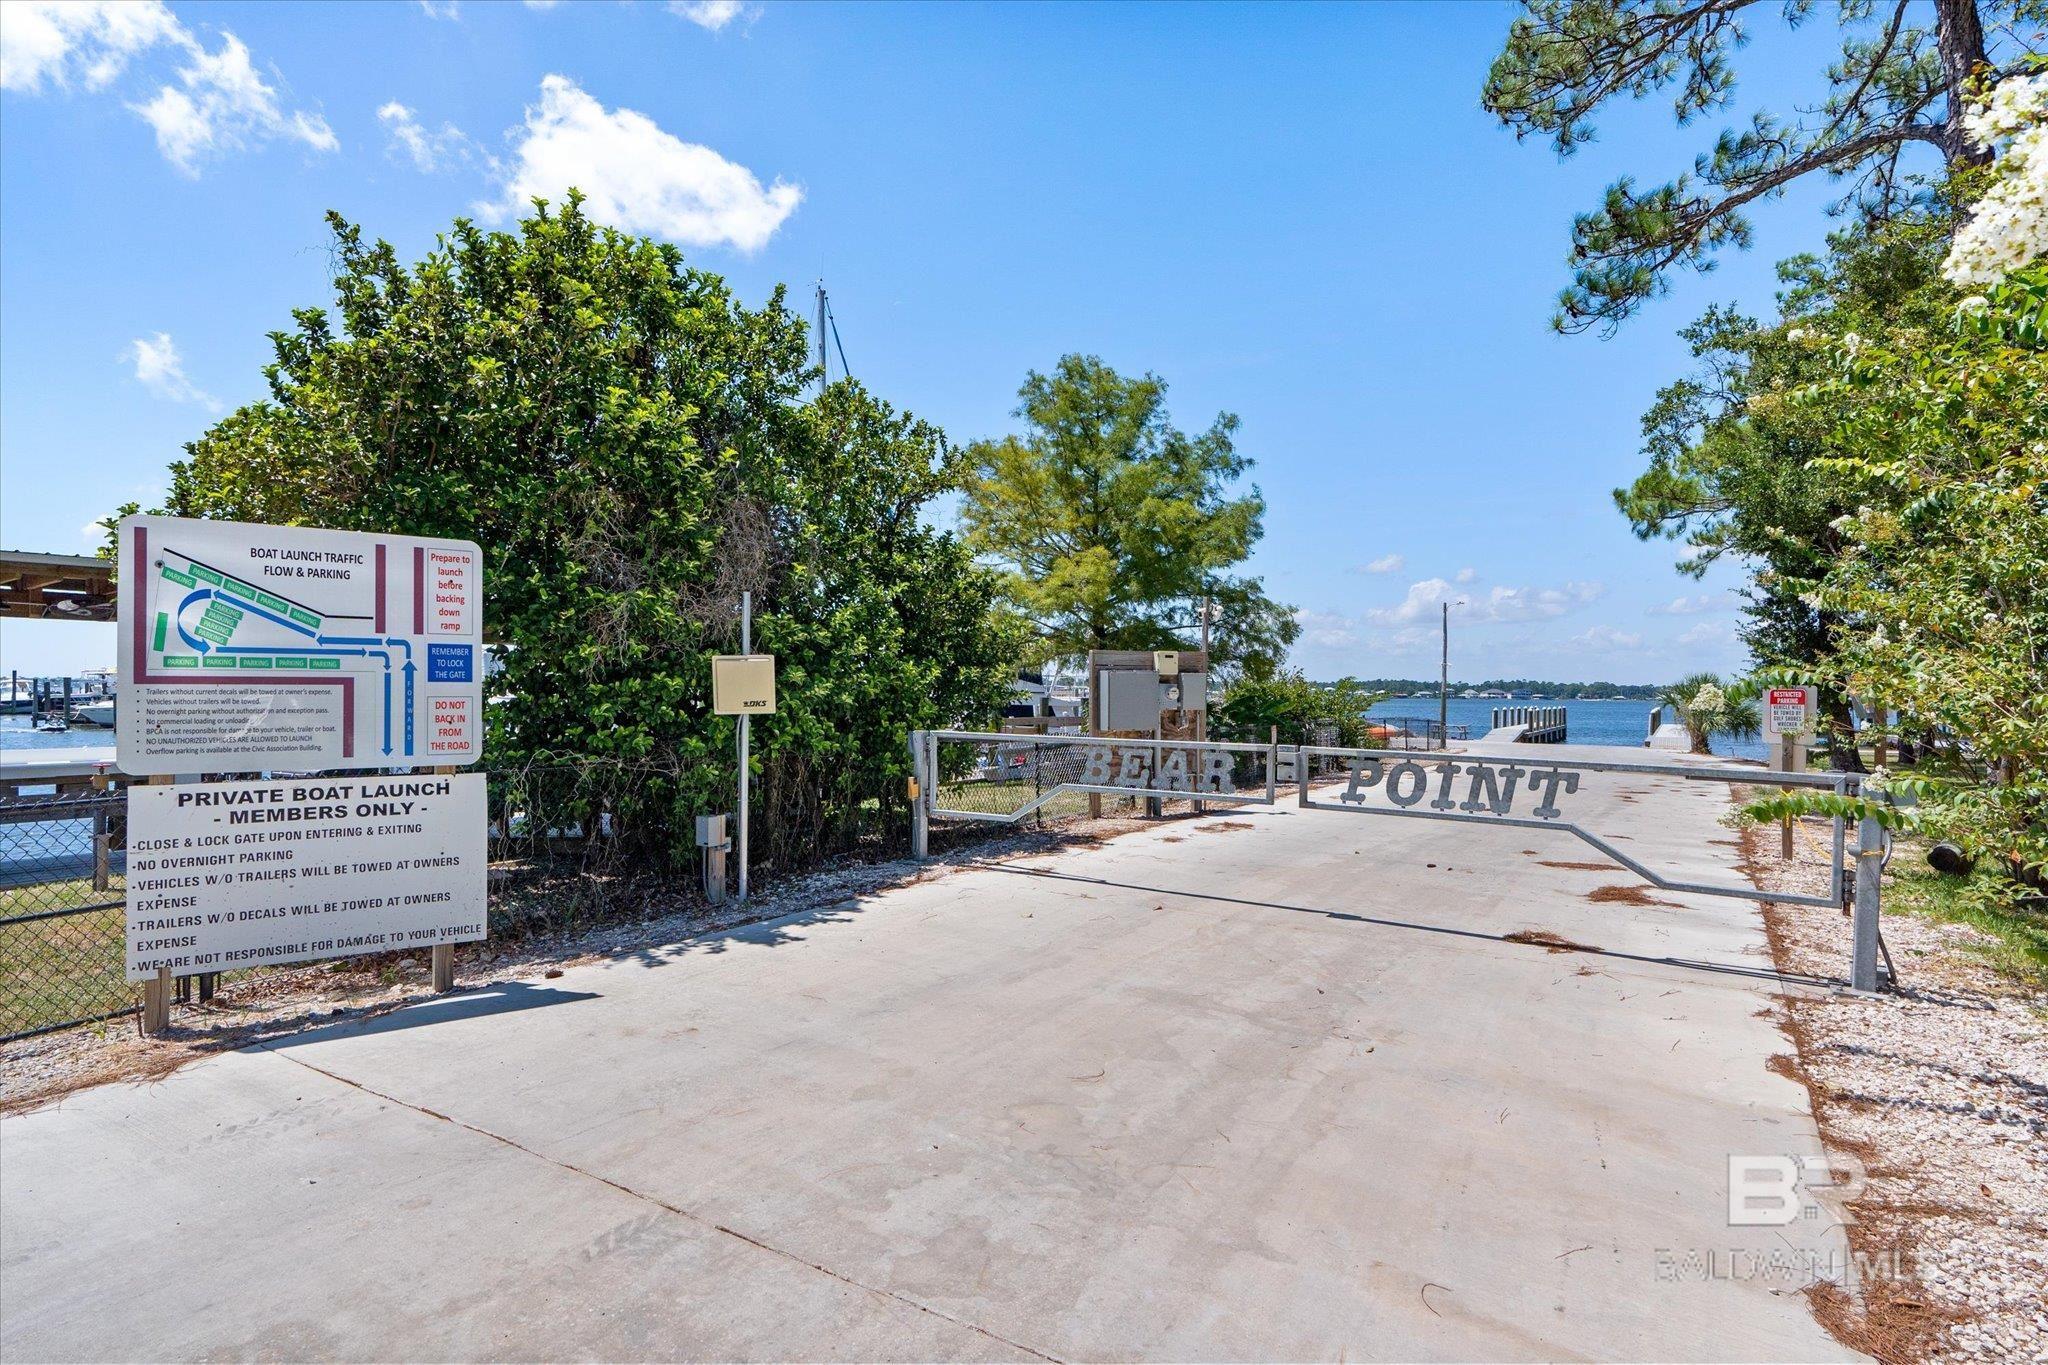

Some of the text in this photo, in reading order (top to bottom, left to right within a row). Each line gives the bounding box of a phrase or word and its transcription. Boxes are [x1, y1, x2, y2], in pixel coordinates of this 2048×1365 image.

[250, 547, 364, 564] BOAT LAUNCH TRAFFIC
[430, 553, 470, 564] Prepare to
[165, 570, 193, 587] PARKING
[192, 567, 219, 584] PARKING
[264, 565, 351, 580] FLOW & PARKING
[437, 567, 463, 576] launch
[227, 582, 253, 597] PARKING
[438, 580, 463, 590] before
[260, 596, 285, 611] PARKING
[436, 594, 465, 605] backing
[214, 603, 240, 617] PARKING
[439, 608, 460, 616] down
[209, 611, 235, 626] PARKING
[293, 611, 317, 626] PARKING
[203, 620, 229, 635] PARKING
[440, 623, 460, 632] ramp
[197, 628, 225, 644] PARKING
[431, 648, 469, 656] REMEMBER
[167, 658, 195, 666] PARKING
[206, 658, 233, 666] PARKING
[312, 660, 337, 668] PARKING
[436, 659, 464, 667] TO LOCK
[156, 708, 187, 716] overnight
[187, 708, 210, 716] parking
[435, 701, 465, 710] DO NOT
[435, 715, 465, 723] BACK IN
[182, 728, 218, 736] responsible
[438, 728, 462, 737] FROM
[175, 747, 199, 755] parking
[206, 746, 232, 754] available
[431, 742, 470, 750] THE ROAD
[1079, 746, 1581, 818] BEAR POINT
[178, 782, 450, 807] PRIVATE BOAT LAUNCH
[229, 805, 348, 825] MEMBERS
[356, 802, 415, 817] ONLY
[137, 823, 422, 851] CLOSE & LOCK GATE UPON ENTERING & EXITING
[137, 850, 293, 871] NO OVERNIGHT PARKING
[137, 856, 460, 891] VEHICLES W/O TRAILERS WILL BE TOWED AT OWNERS
[137, 896, 197, 912] EXPENSE
[137, 892, 451, 931] TRAILERS W/O DECALS WILL BE TOWED AT OWNERS
[137, 936, 197, 951] EXPENSE
[137, 924, 481, 972] WE ARE NOT RESPONSIBLE FOR DAMAGE TO YOUR VEHICLE
